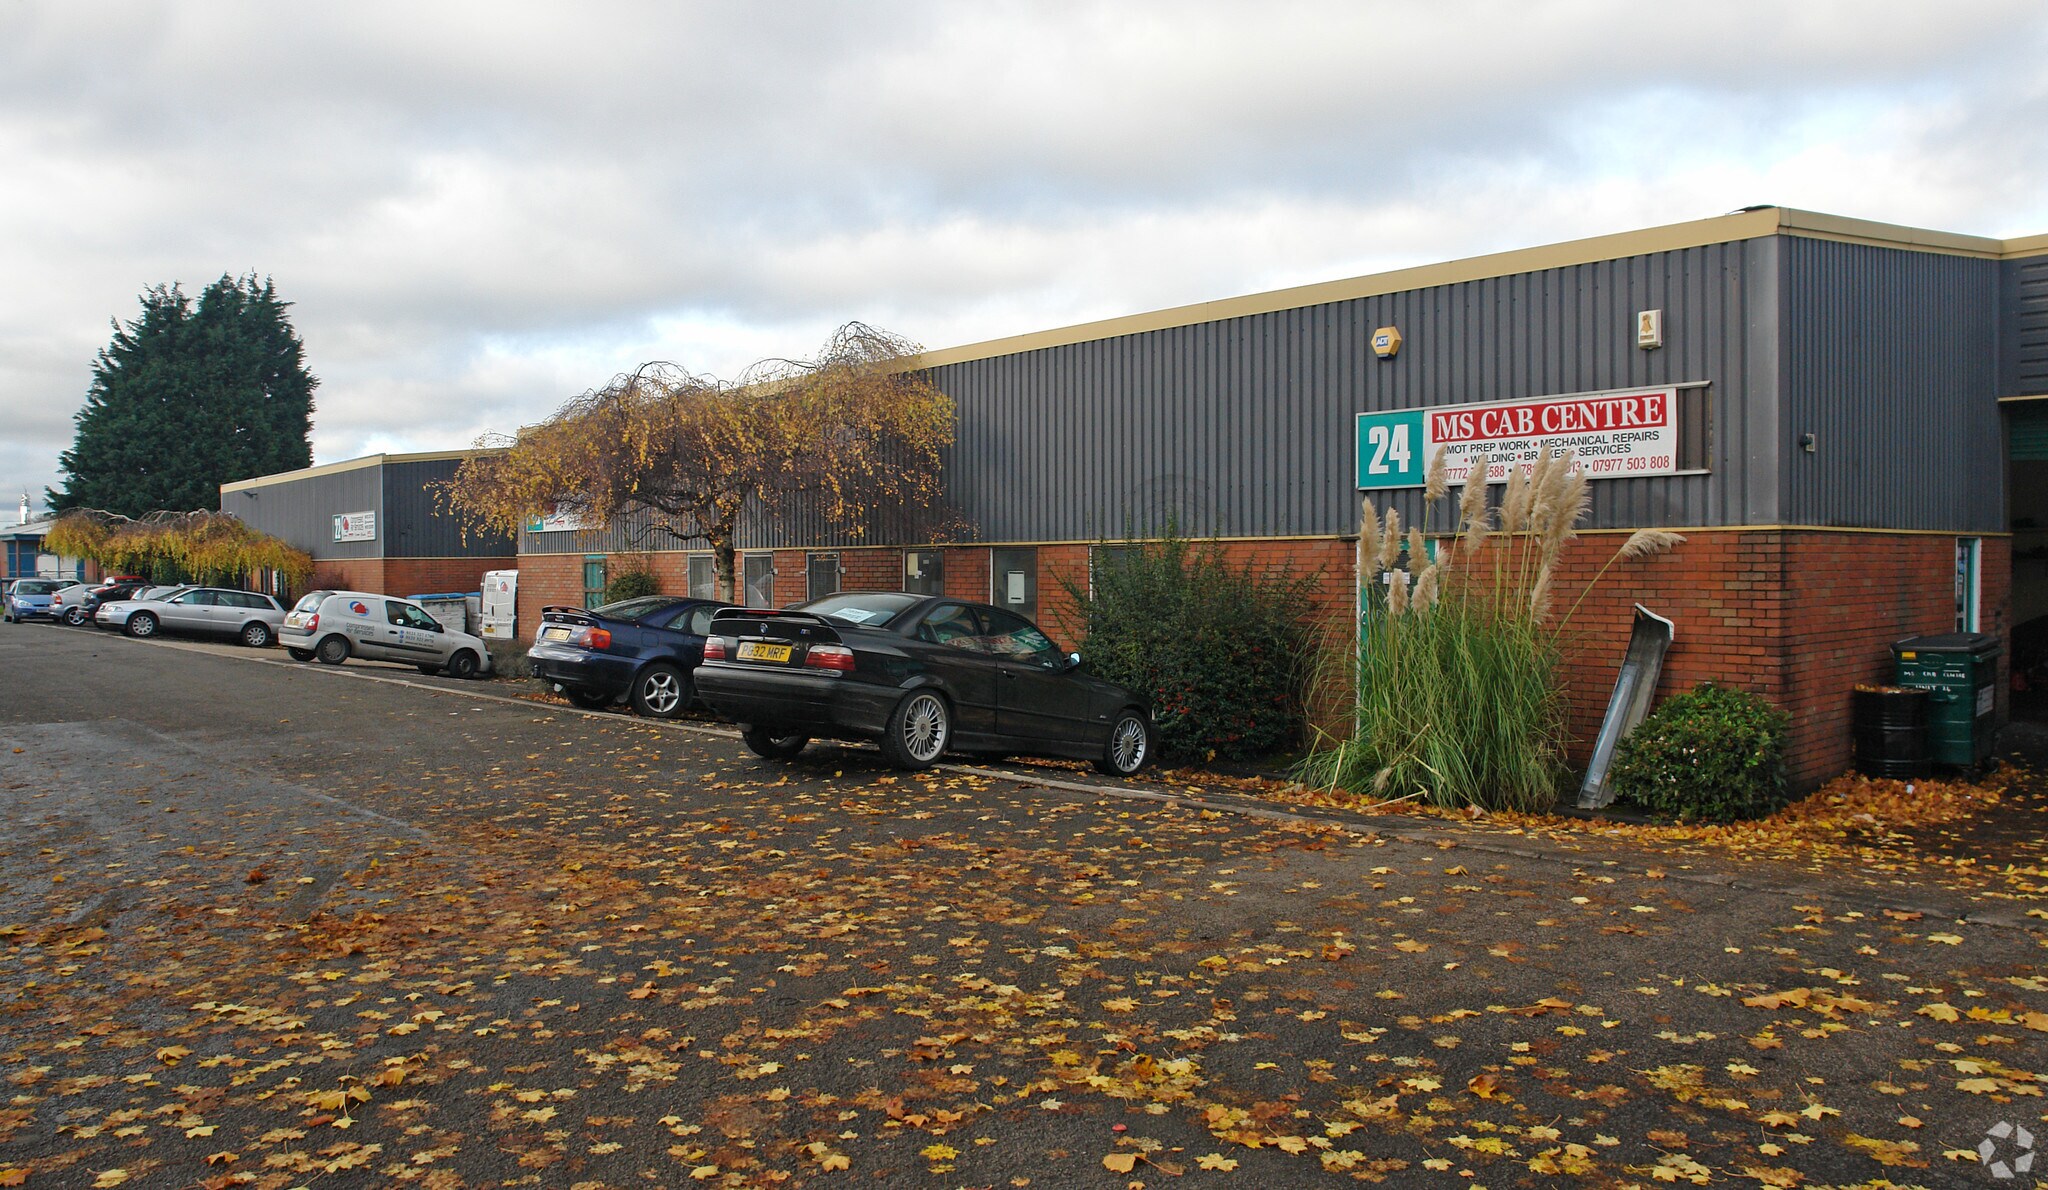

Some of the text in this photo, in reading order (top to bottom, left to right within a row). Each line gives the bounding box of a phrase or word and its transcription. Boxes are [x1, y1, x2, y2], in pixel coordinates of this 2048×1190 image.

[1436, 396, 1662, 440] MS CAB CENTRE
[1368, 424, 1410, 474] 24
[1446, 431, 1659, 454] MOT PREP WORK MECHANICAL REPAIRS
[1470, 443, 1631, 464] WLDING BRKES SERVICES
[1489, 465, 1505, 478] 588
[1593, 458, 1623, 472] 07977
[1626, 456, 1646, 470] 503
[1650, 455, 1670, 469] 808
[767, 646, 787, 659] MRF
